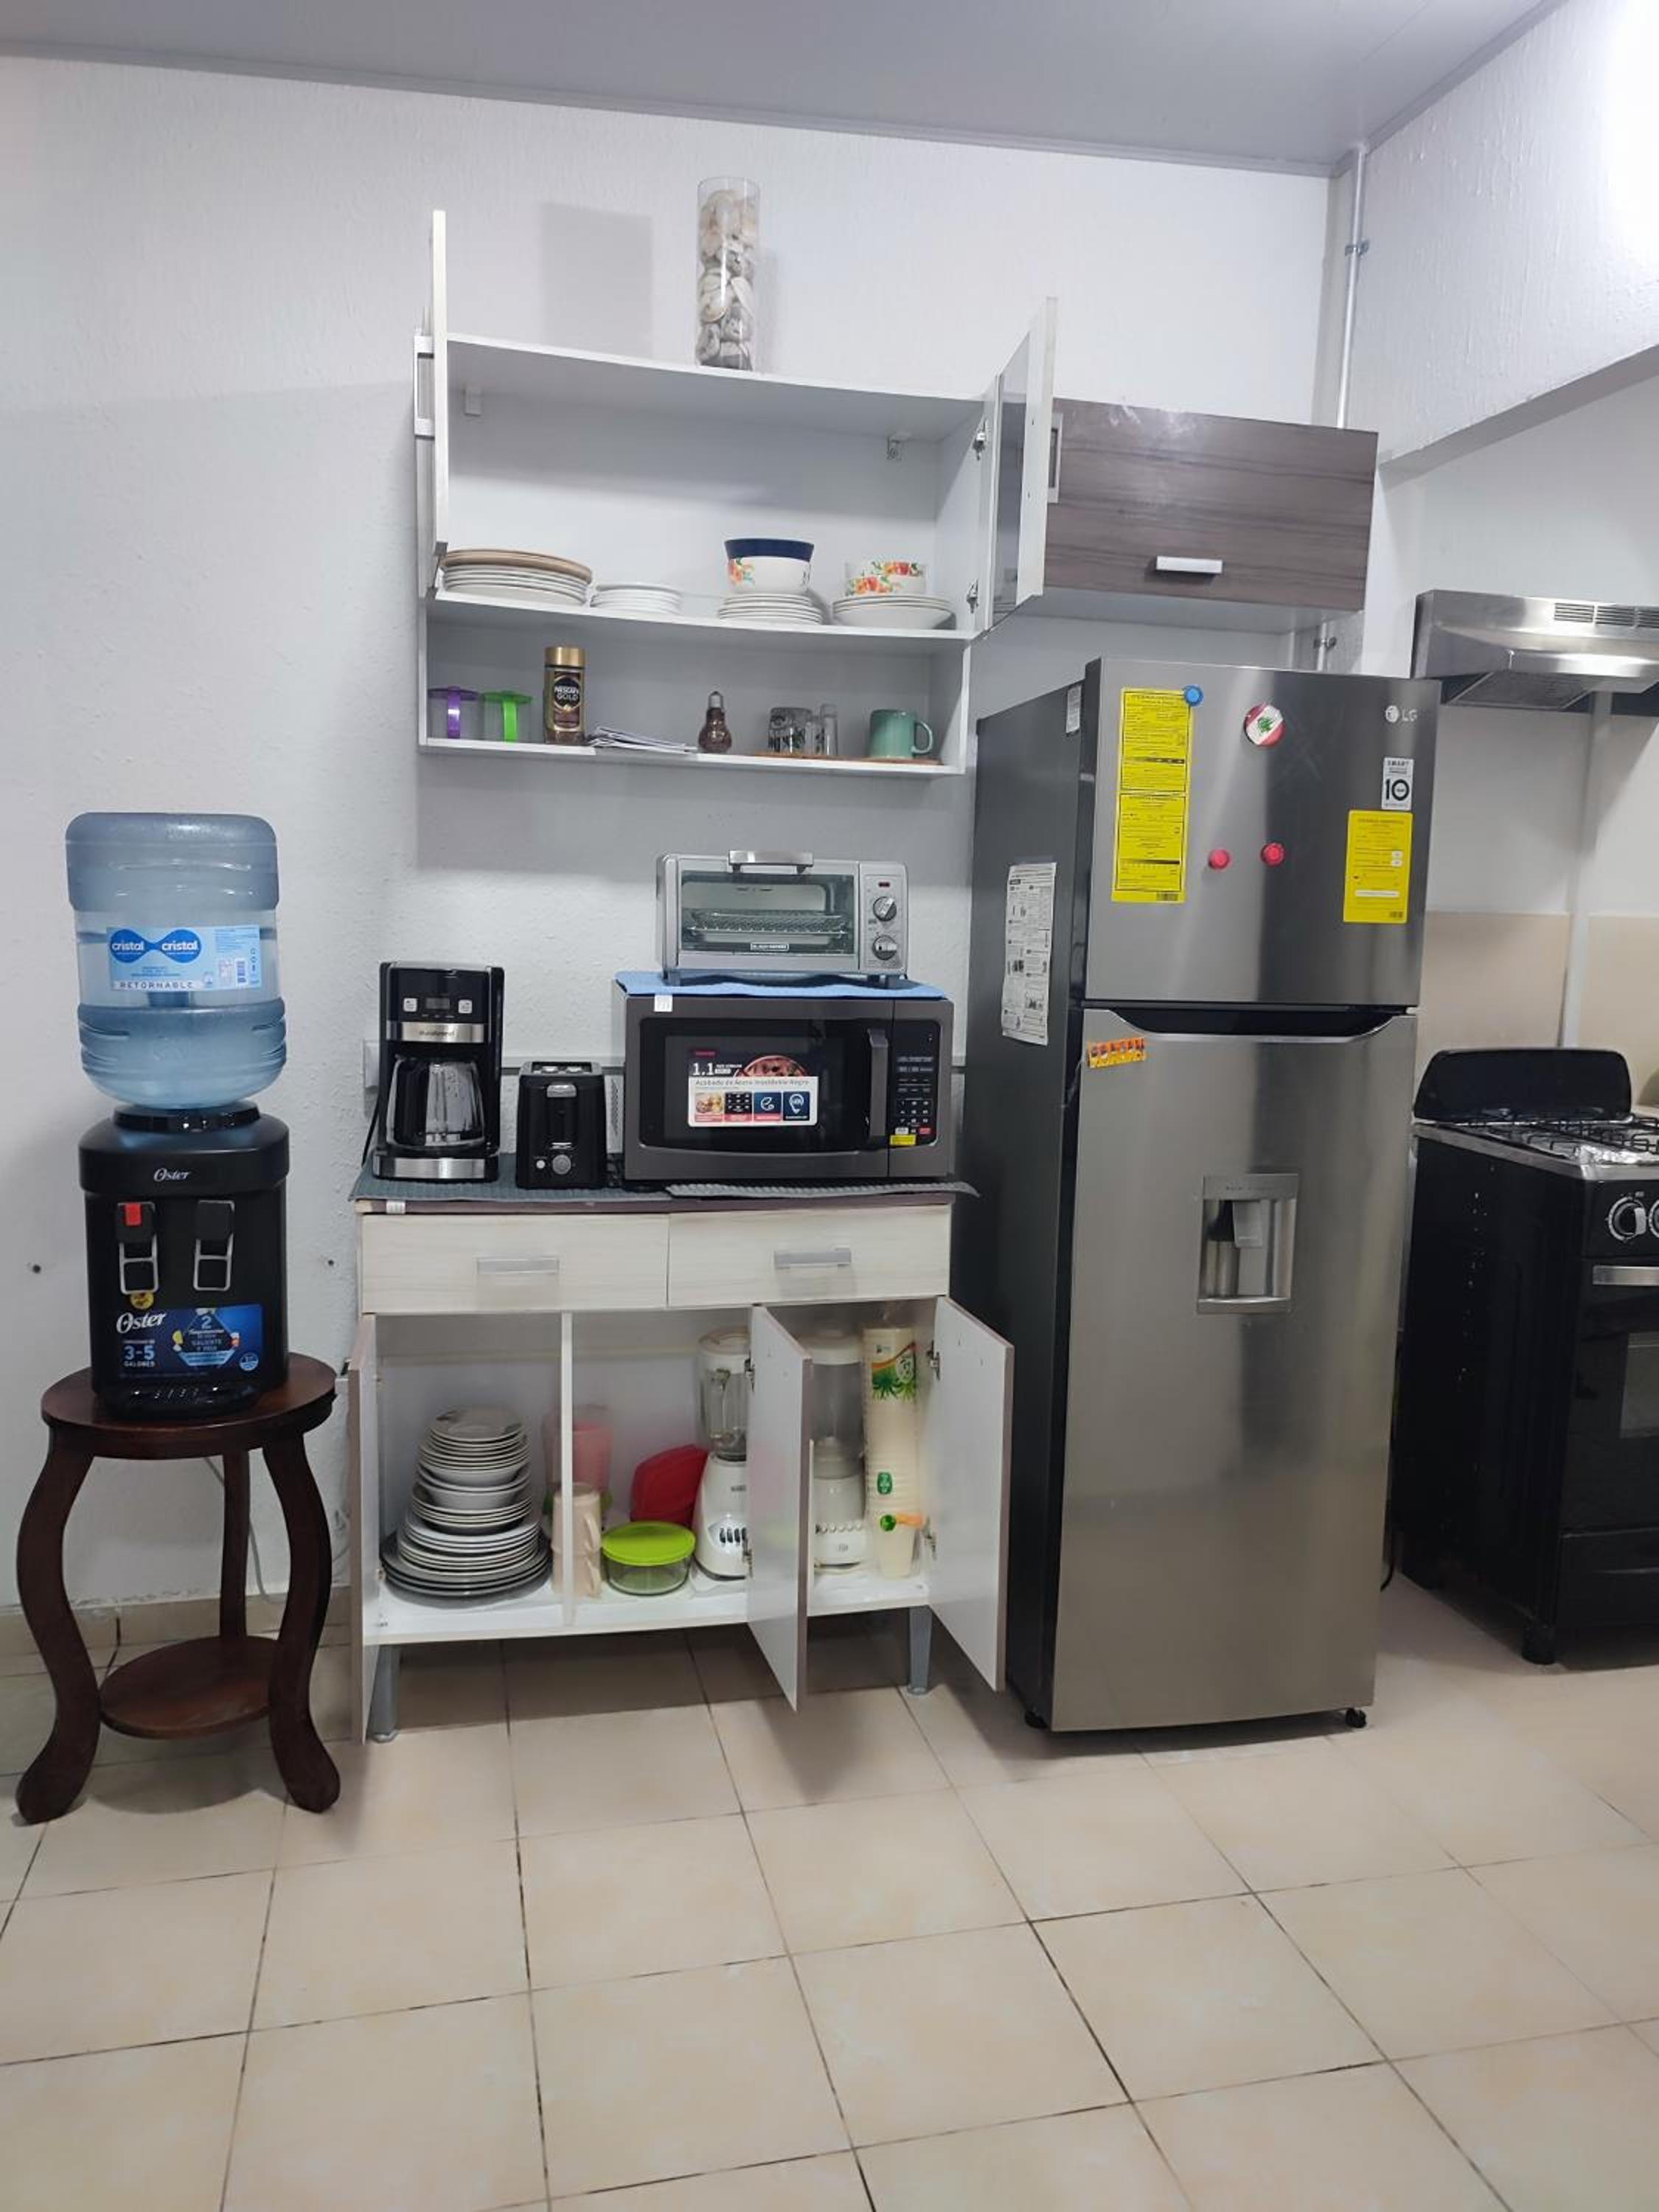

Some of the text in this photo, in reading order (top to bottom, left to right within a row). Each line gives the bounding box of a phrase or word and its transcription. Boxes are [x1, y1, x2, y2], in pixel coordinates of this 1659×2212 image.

[1402, 708, 1418, 722] LG
[1385, 779, 1410, 801] 10
[111, 941, 145, 951] cristal
[161, 940, 198, 951] cristal
[119, 981, 193, 990] RETORNABLE
[692, 1062, 714, 1076] 1.1
[153, 1167, 190, 1182] Oster
[116, 1312, 167, 1334] Oster
[201, 1315, 213, 1329] 2
